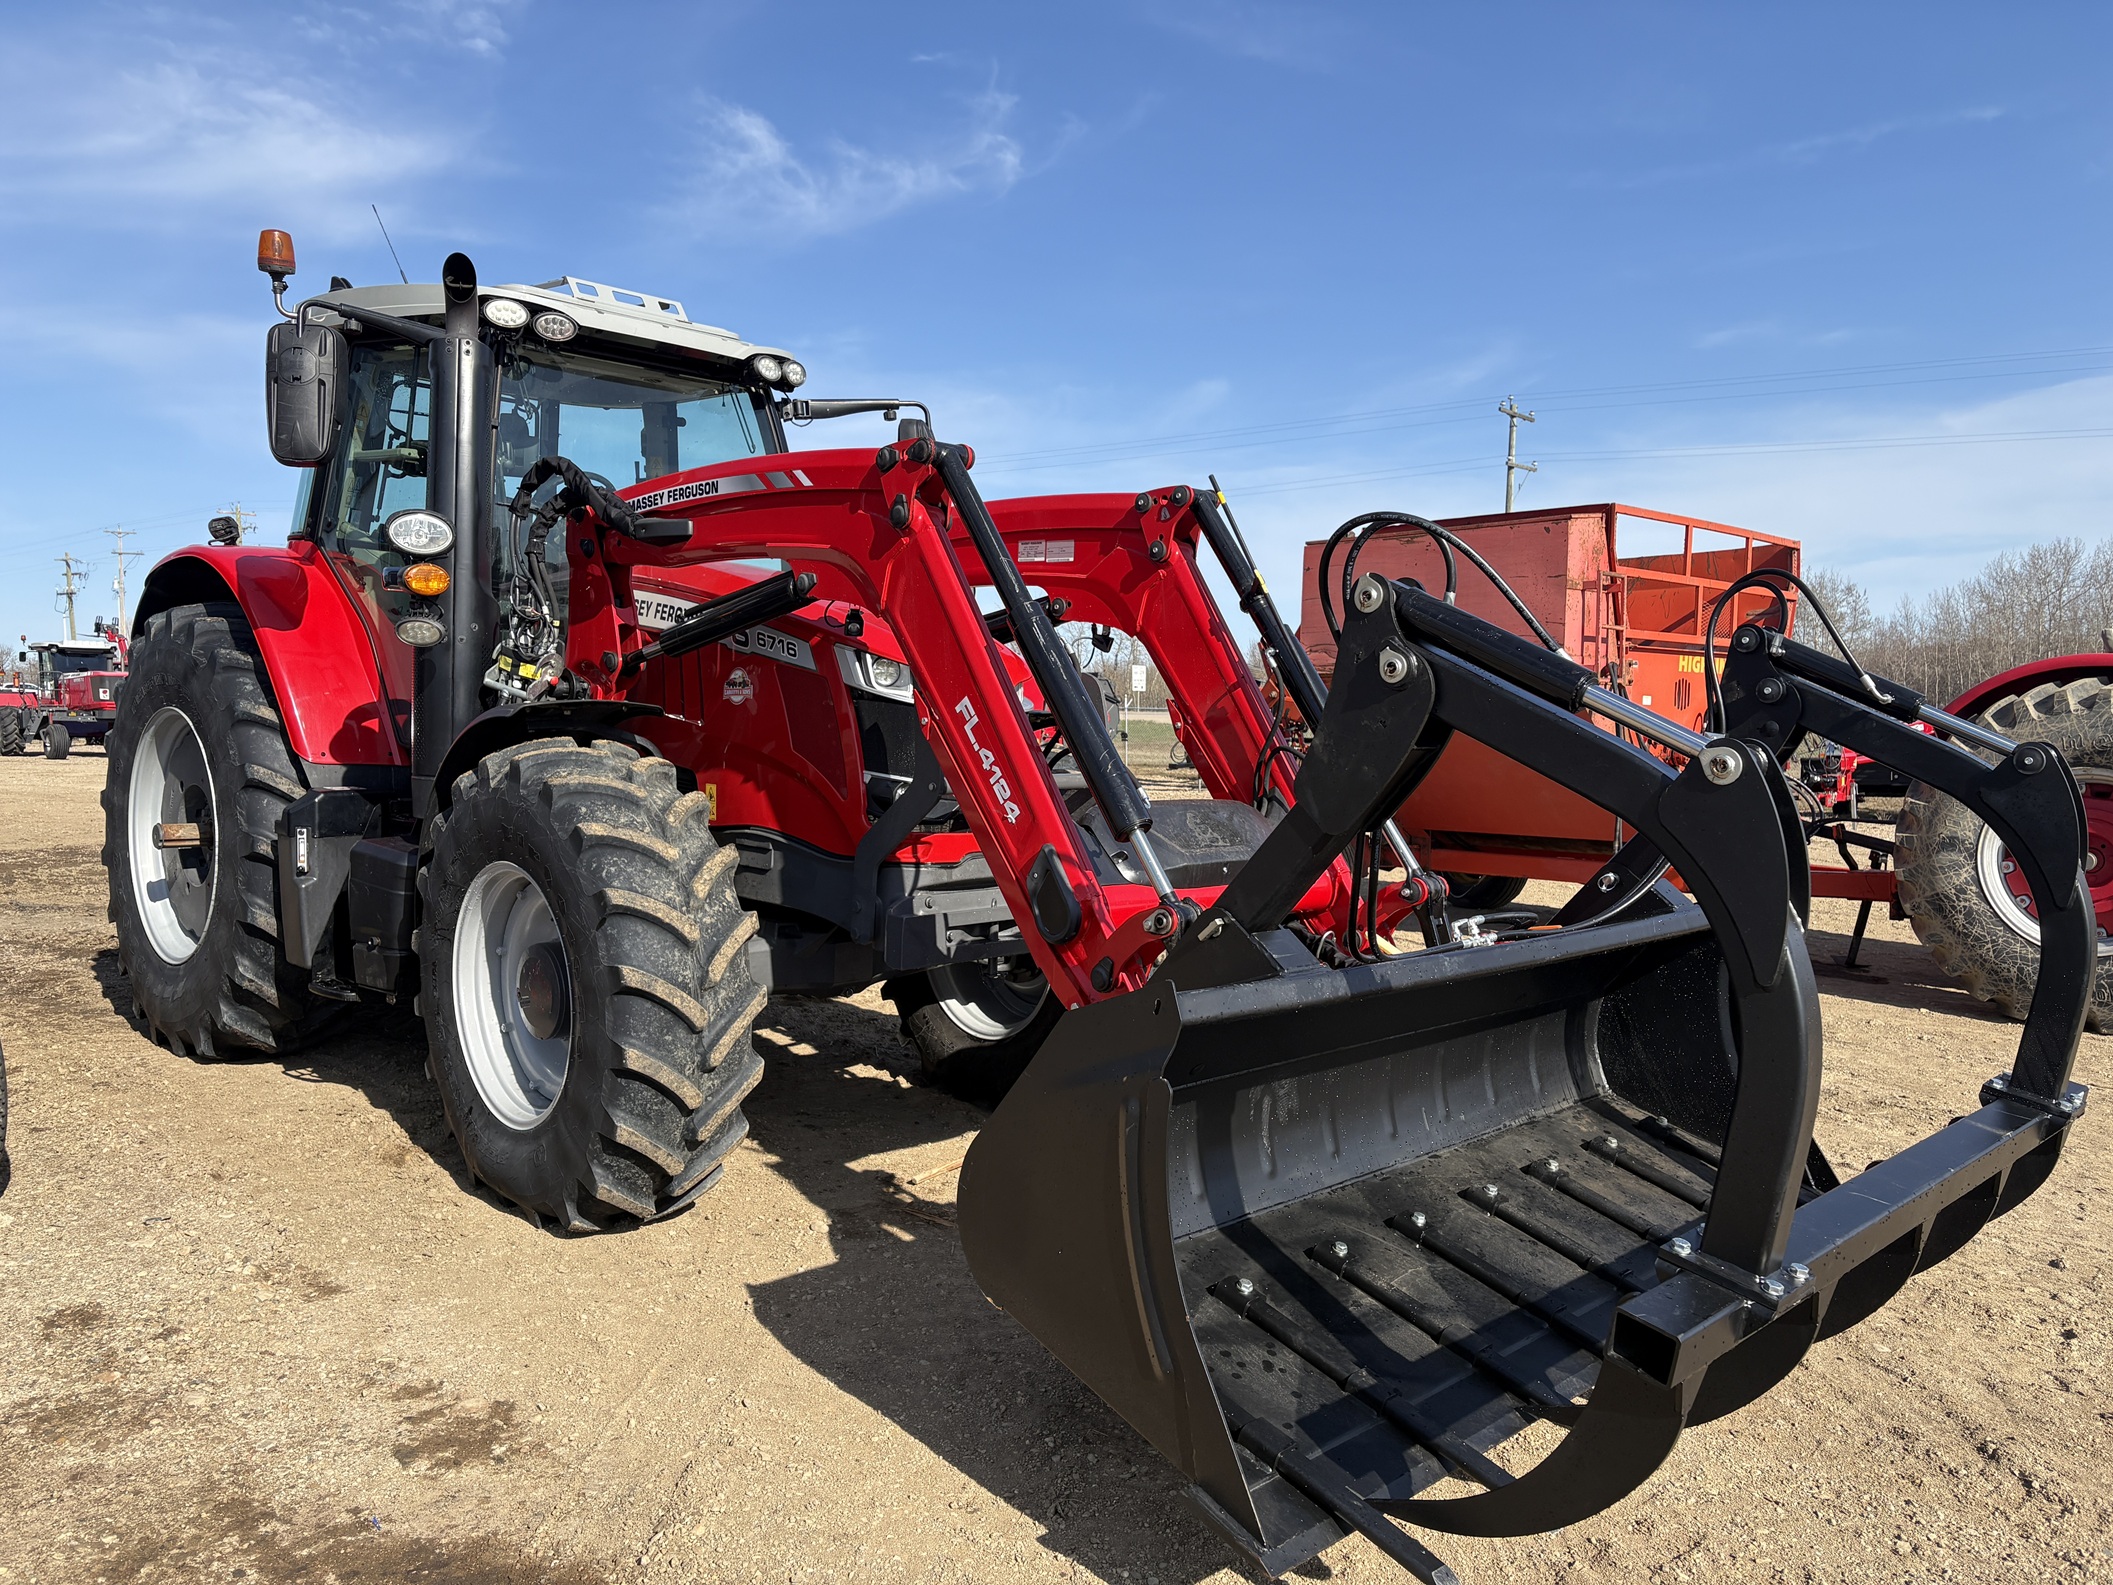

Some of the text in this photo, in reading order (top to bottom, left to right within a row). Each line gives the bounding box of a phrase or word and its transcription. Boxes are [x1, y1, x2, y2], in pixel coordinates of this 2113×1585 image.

[629, 480, 719, 512] MASSEY FERGUSON
[756, 629, 798, 659] 6716
[954, 695, 1021, 824] FL.4124
